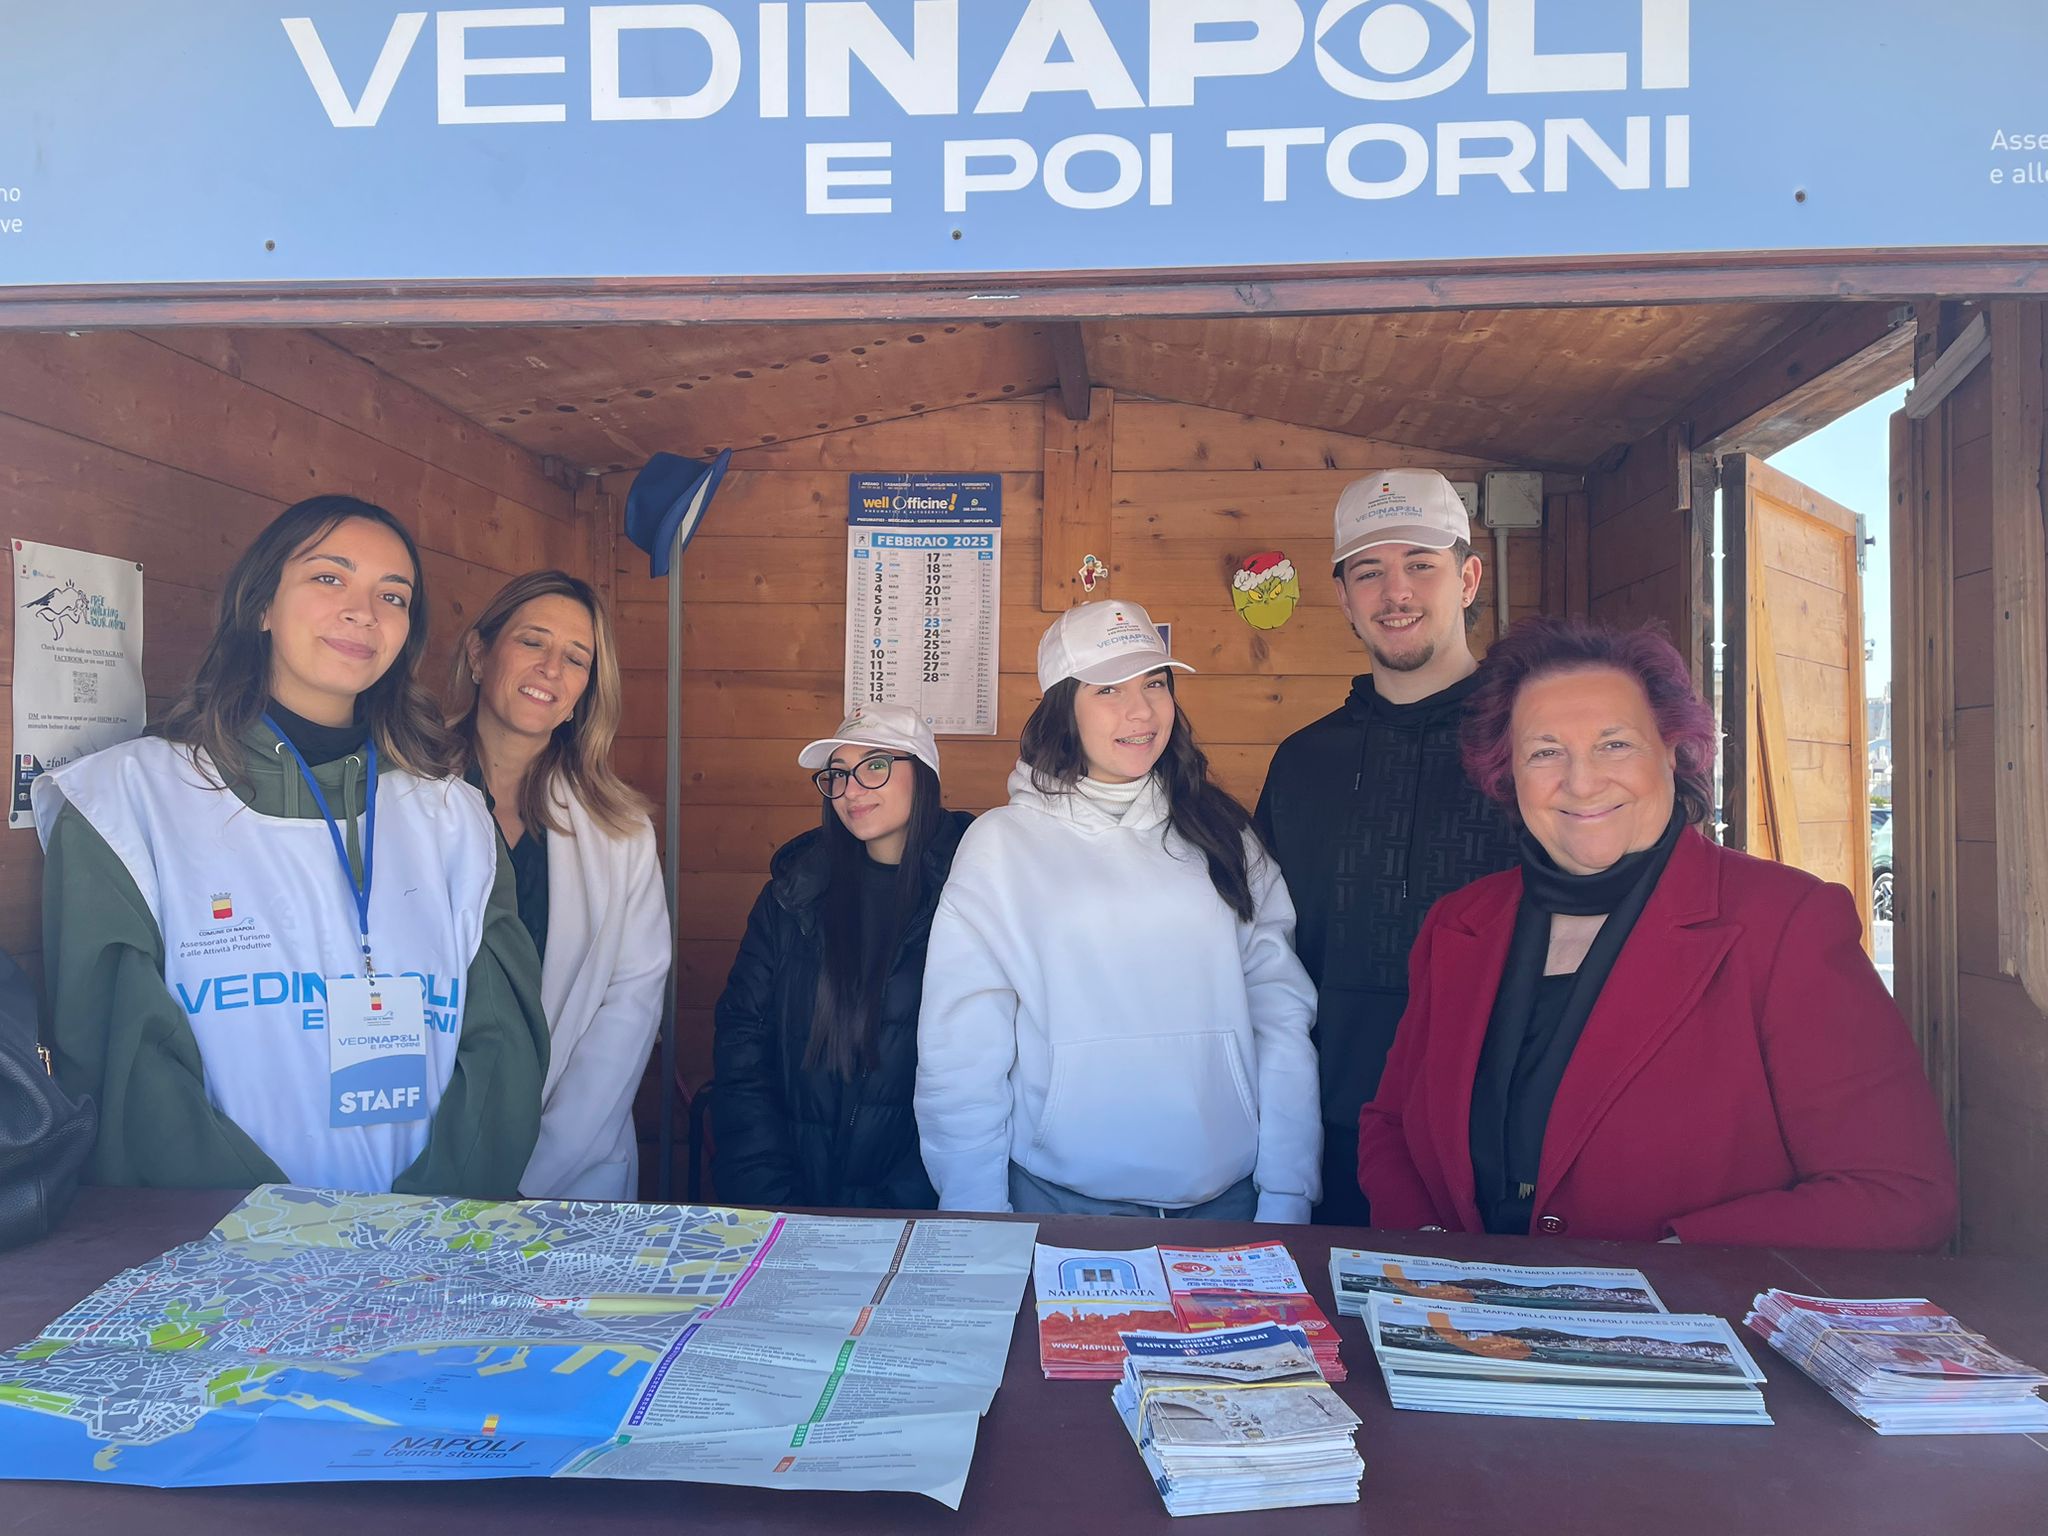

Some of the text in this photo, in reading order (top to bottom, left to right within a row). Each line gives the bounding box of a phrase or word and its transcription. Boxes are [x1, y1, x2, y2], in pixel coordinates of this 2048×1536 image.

[281, 0, 1690, 128] VEDINAPOLI
[806, 114, 1691, 215] E POI TORNI
[1989, 168, 2004, 184] e
[863, 496, 890, 508] well
[878, 536, 989, 547] FEBBRAIO 2025
[927, 552, 940, 562] 17
[875, 562, 883, 572] 2
[926, 564, 940, 573] 18
[875, 573, 882, 582] 3
[926, 575, 940, 584] 19
[874, 584, 882, 593] 4
[925, 586, 941, 595] 20
[874, 595, 882, 604] 5
[925, 597, 938, 606] 21
[874, 606, 882, 615] 6
[874, 617, 881, 626] 7
[924, 618, 940, 627] 23
[874, 628, 881, 637] 8
[924, 629, 940, 638] 24
[873, 638, 881, 648] 9
[924, 640, 939, 649] 25
[870, 650, 884, 659] 10
[924, 651, 940, 660] 26
[870, 661, 882, 670] 11
[923, 662, 939, 671] 27
[870, 672, 884, 680] 12
[923, 673, 939, 682] 28
[870, 682, 883, 692] 13
[870, 693, 883, 702] 14
[46, 756, 71, 768] #foll
[180, 938, 227, 949] Assessorato
[239, 933, 270, 941] Turismo
[203, 946, 230, 955] Attività
[232, 942, 272, 951] Produttive
[303, 1009, 324, 1030] E
[338, 1034, 420, 1046] VEDINAPOLI
[338, 1086, 420, 1114] STAFF
[1048, 1288, 1156, 1298] NAPULITANATA
[1170, 1340, 1218, 1350] LUCIELLA
[1236, 1333, 1268, 1342] LIBRAI
[391, 1436, 528, 1452] NAPOLI
[384, 1448, 508, 1460] Centro storico
